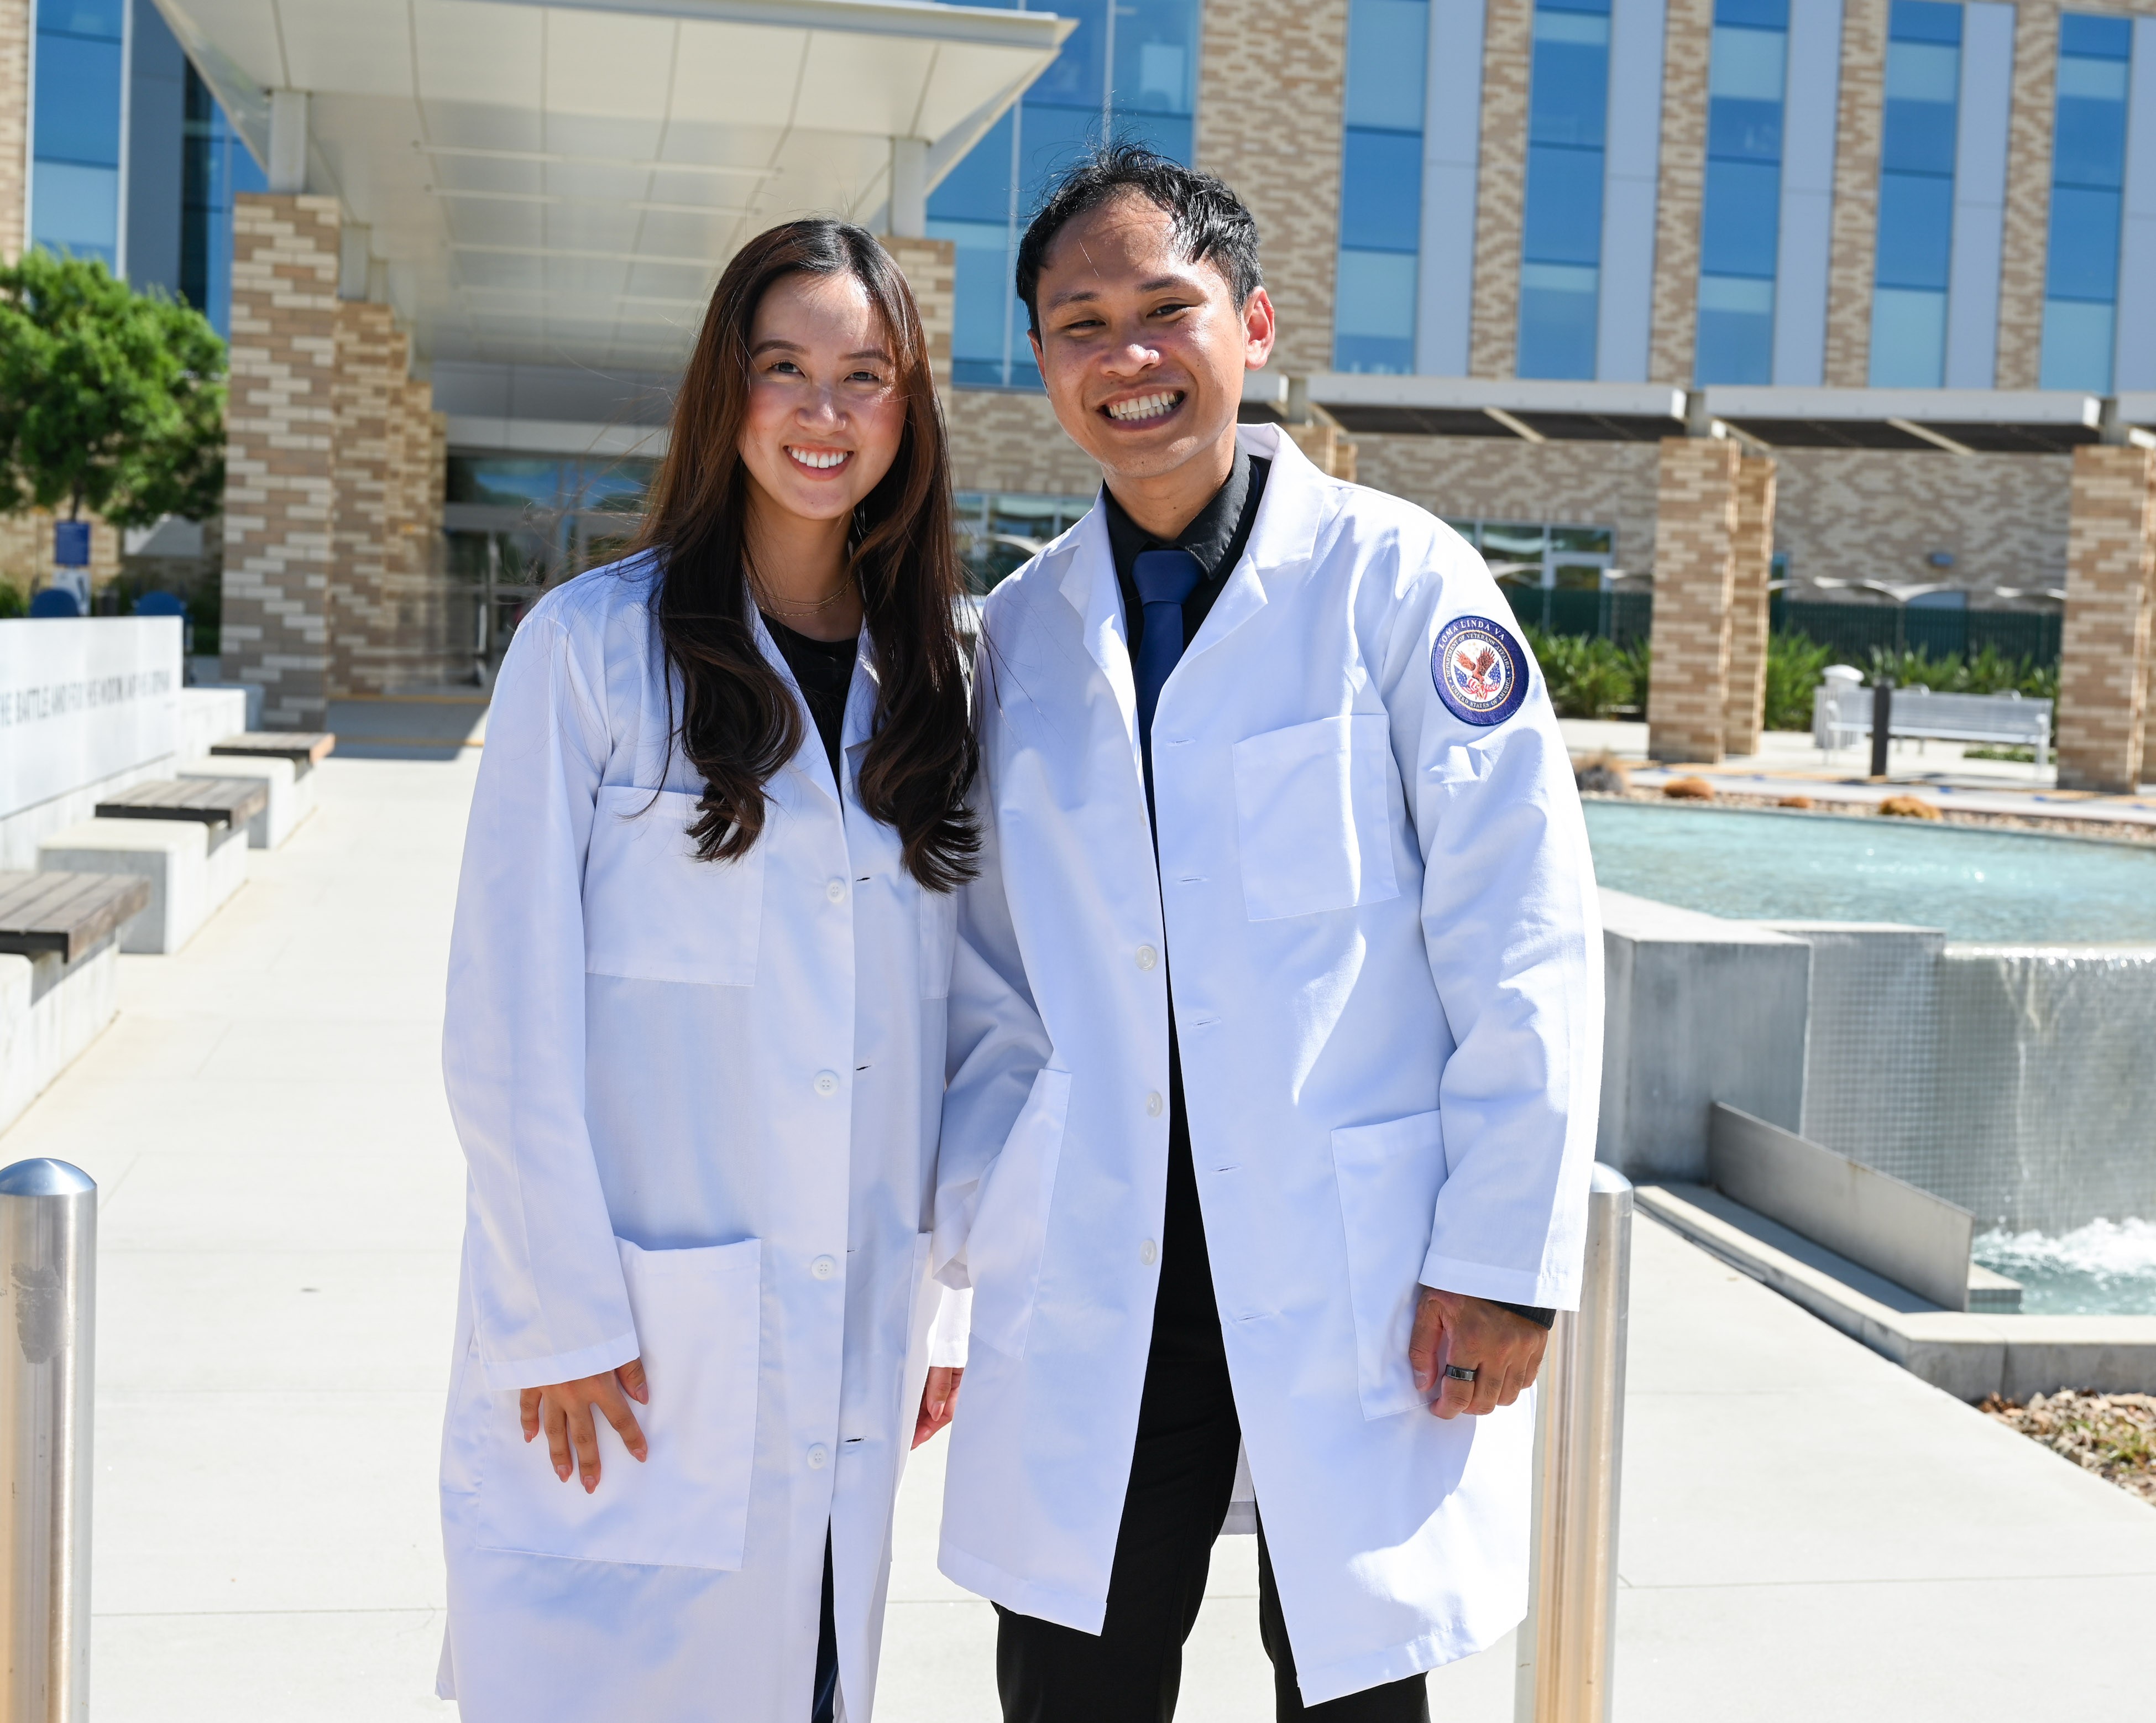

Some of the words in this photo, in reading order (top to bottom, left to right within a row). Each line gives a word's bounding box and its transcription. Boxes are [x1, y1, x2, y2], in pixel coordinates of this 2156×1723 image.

[1438, 624, 1458, 650] LOMA
[1460, 620, 1490, 631] LINDA
[1495, 628, 1504, 641] VA
[1446, 639, 1458, 677] DEPARTMENT
[1467, 633, 1495, 646] VETERANS
[1495, 645, 1510, 670] AFFAIRS
[1451, 684, 1469, 704] UNITED
[1498, 676, 1511, 700] AMERICA
